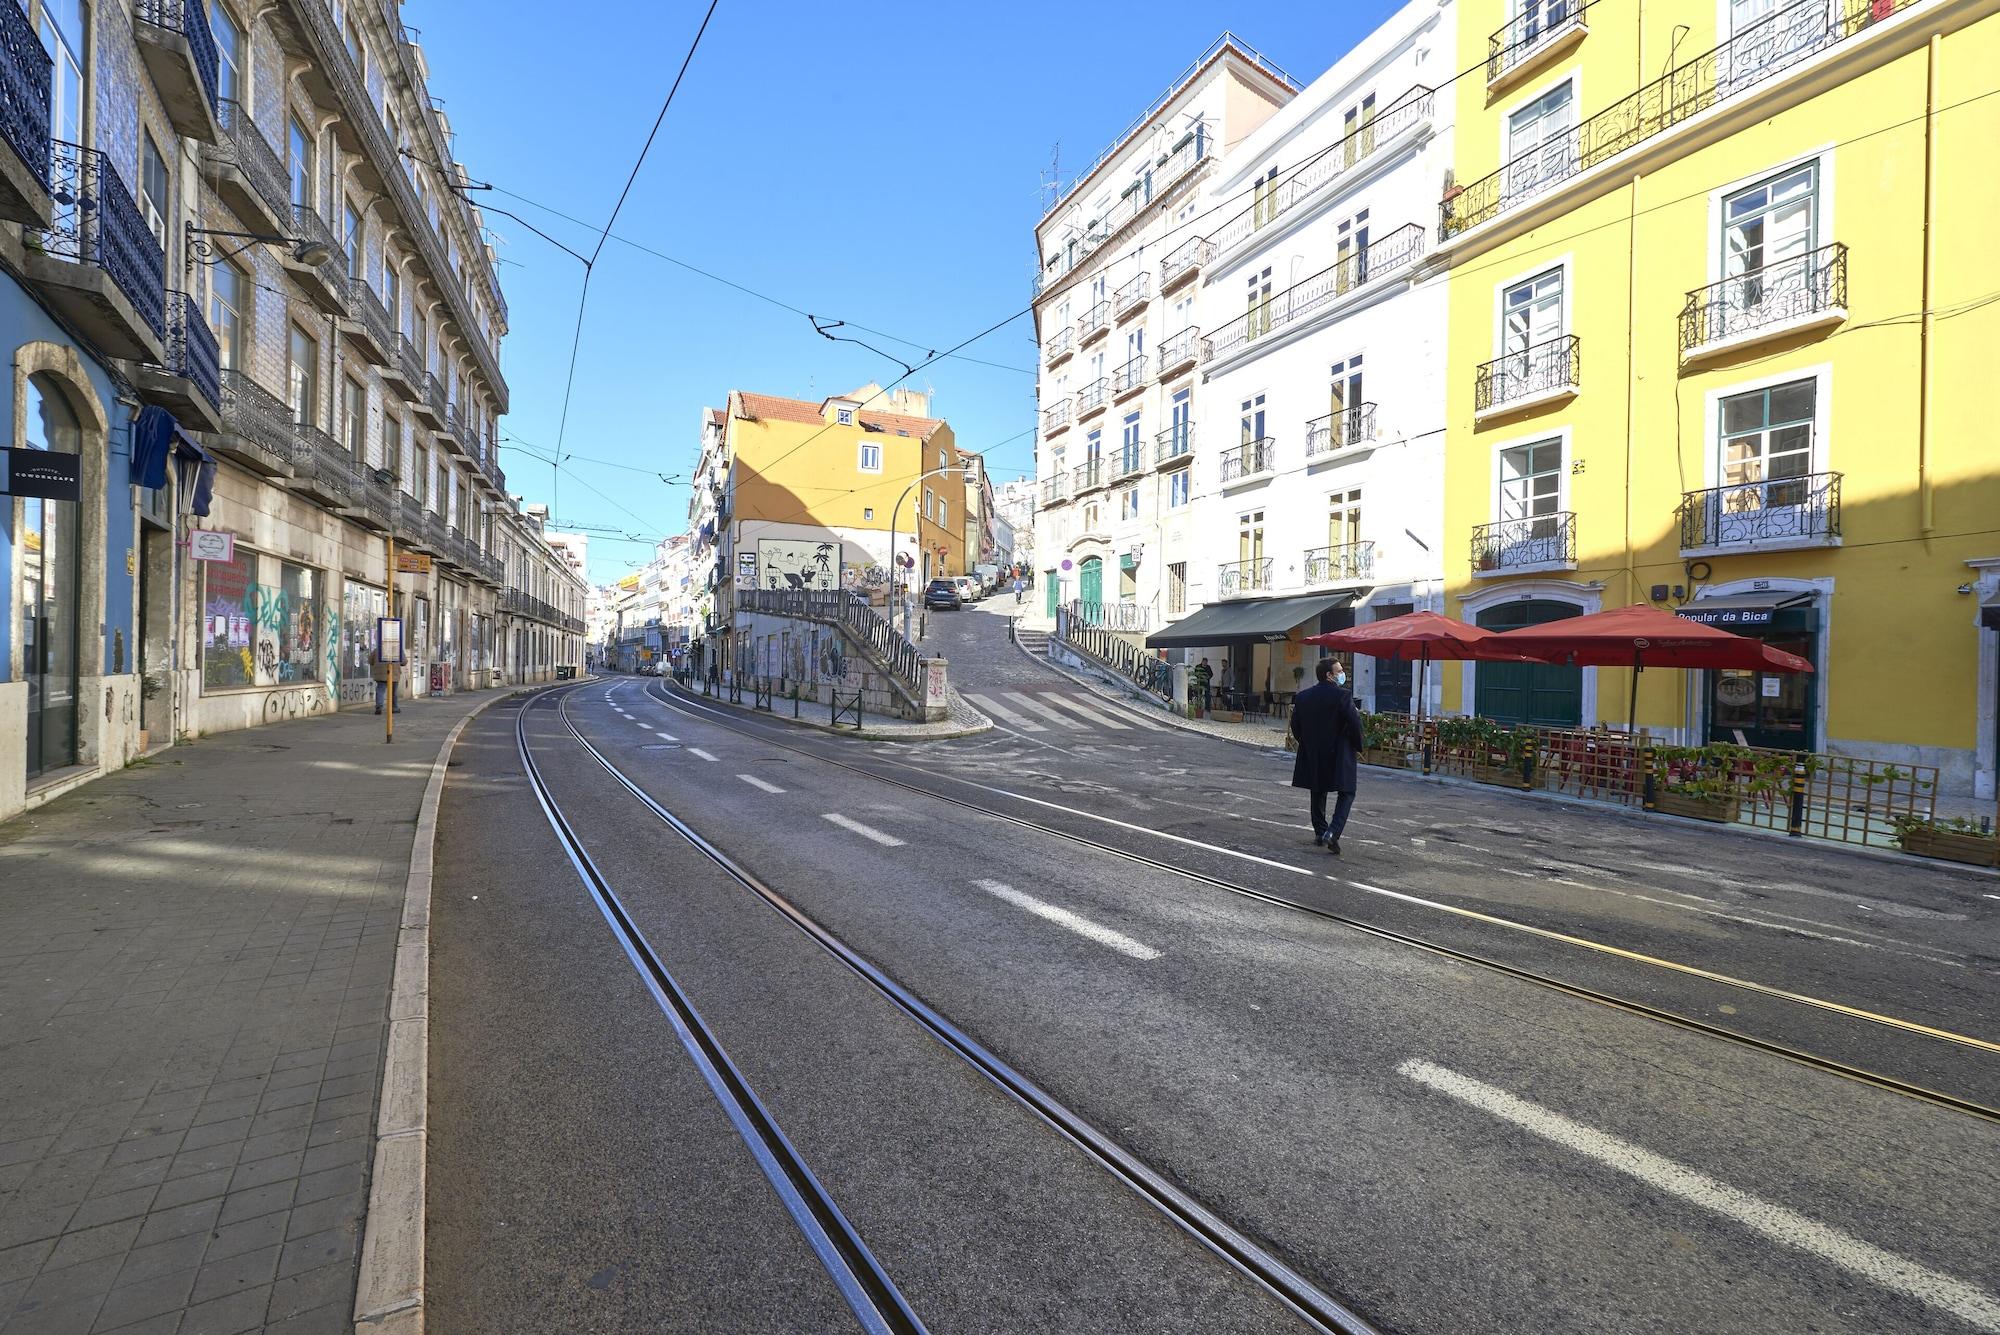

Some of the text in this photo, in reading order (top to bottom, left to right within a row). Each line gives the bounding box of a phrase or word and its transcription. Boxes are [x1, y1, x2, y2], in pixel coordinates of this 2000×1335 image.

[1678, 611, 1768, 623] Popular da Bica
